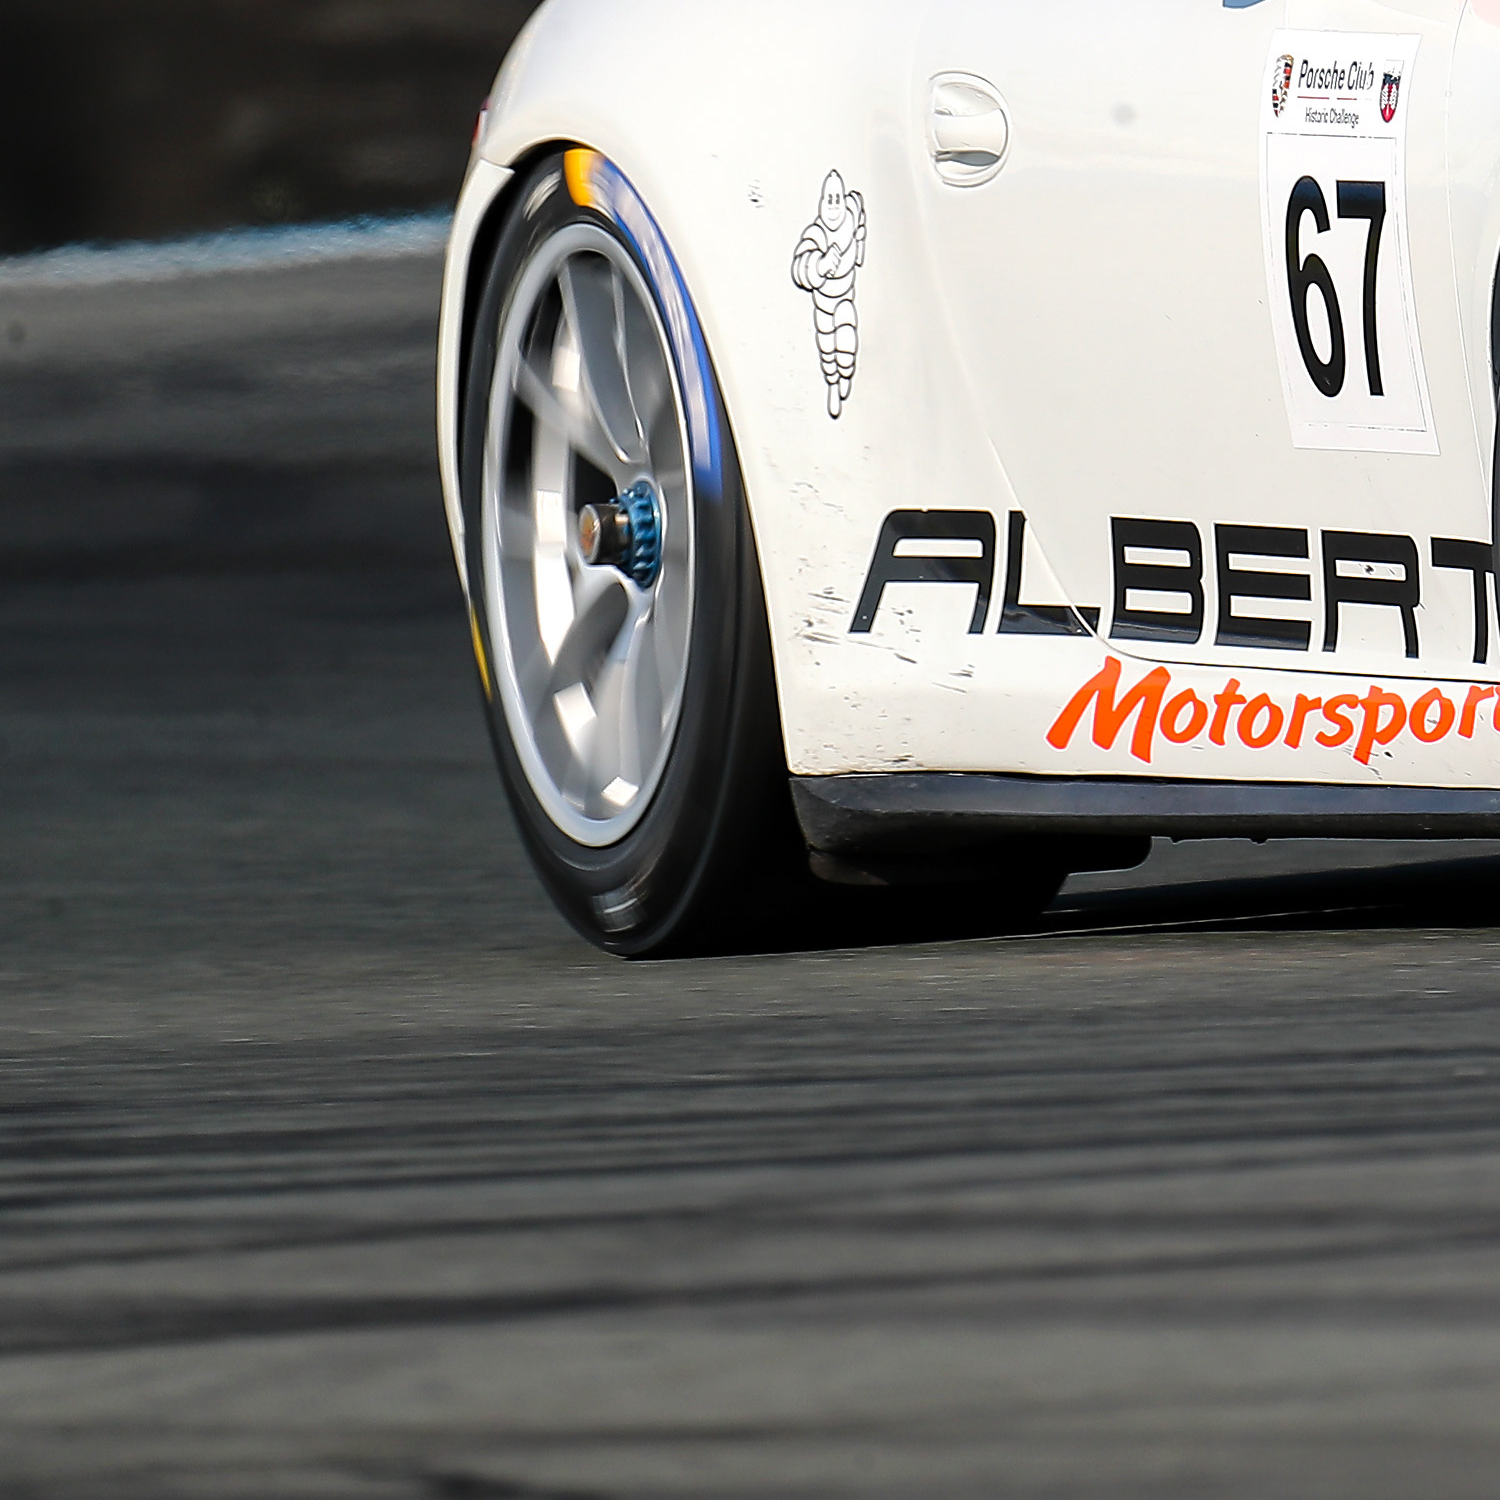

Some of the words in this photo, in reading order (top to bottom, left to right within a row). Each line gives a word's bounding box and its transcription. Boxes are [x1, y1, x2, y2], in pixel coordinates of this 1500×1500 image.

[1297, 59, 1346, 89] Porsche
[1347, 60, 1375, 91] Club
[1285, 175, 1386, 398] 67
[848, 509, 1494, 664] ALBERT
